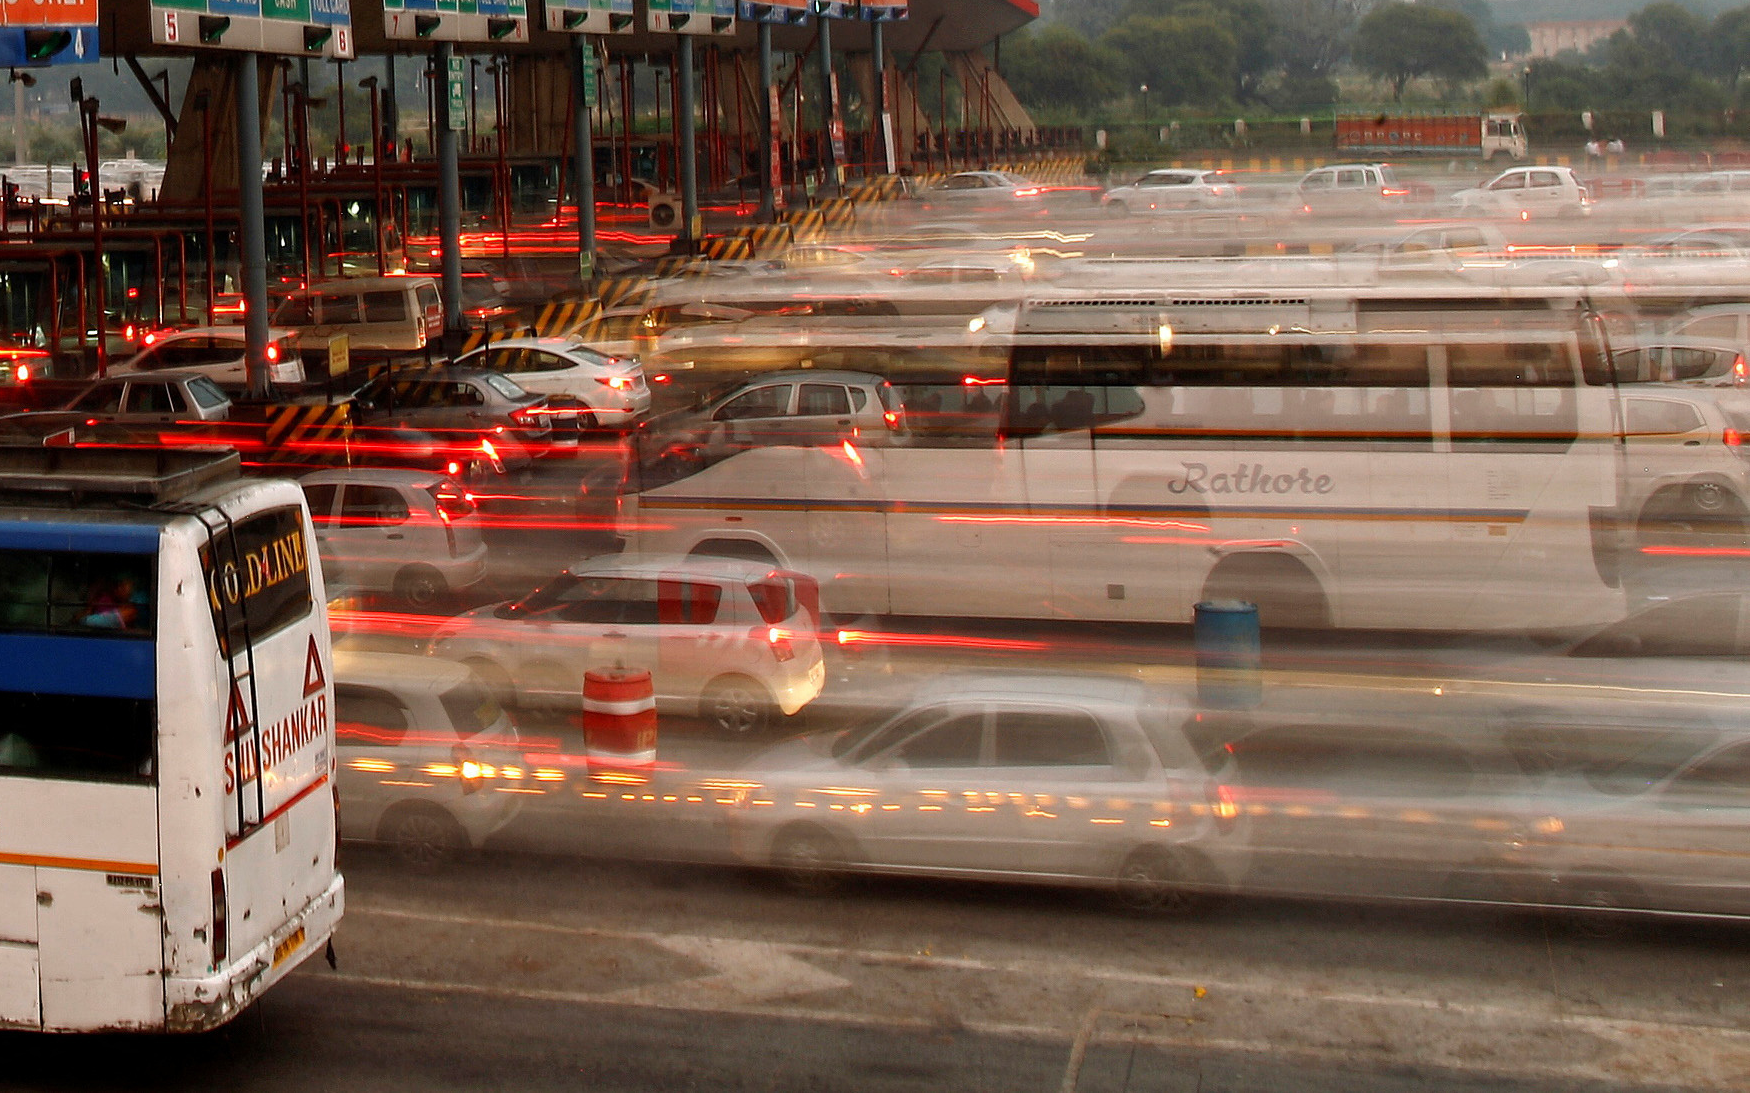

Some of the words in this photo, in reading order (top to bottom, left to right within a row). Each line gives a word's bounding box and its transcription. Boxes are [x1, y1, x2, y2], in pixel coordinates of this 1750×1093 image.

[167, 14, 176, 41] 5
[393, 15, 399, 36] 7
[74, 28, 85, 59] 4
[1167, 461, 1336, 495] Rathore
[210, 530, 306, 612] ODLINE
[262, 693, 327, 772] SHANKAR
